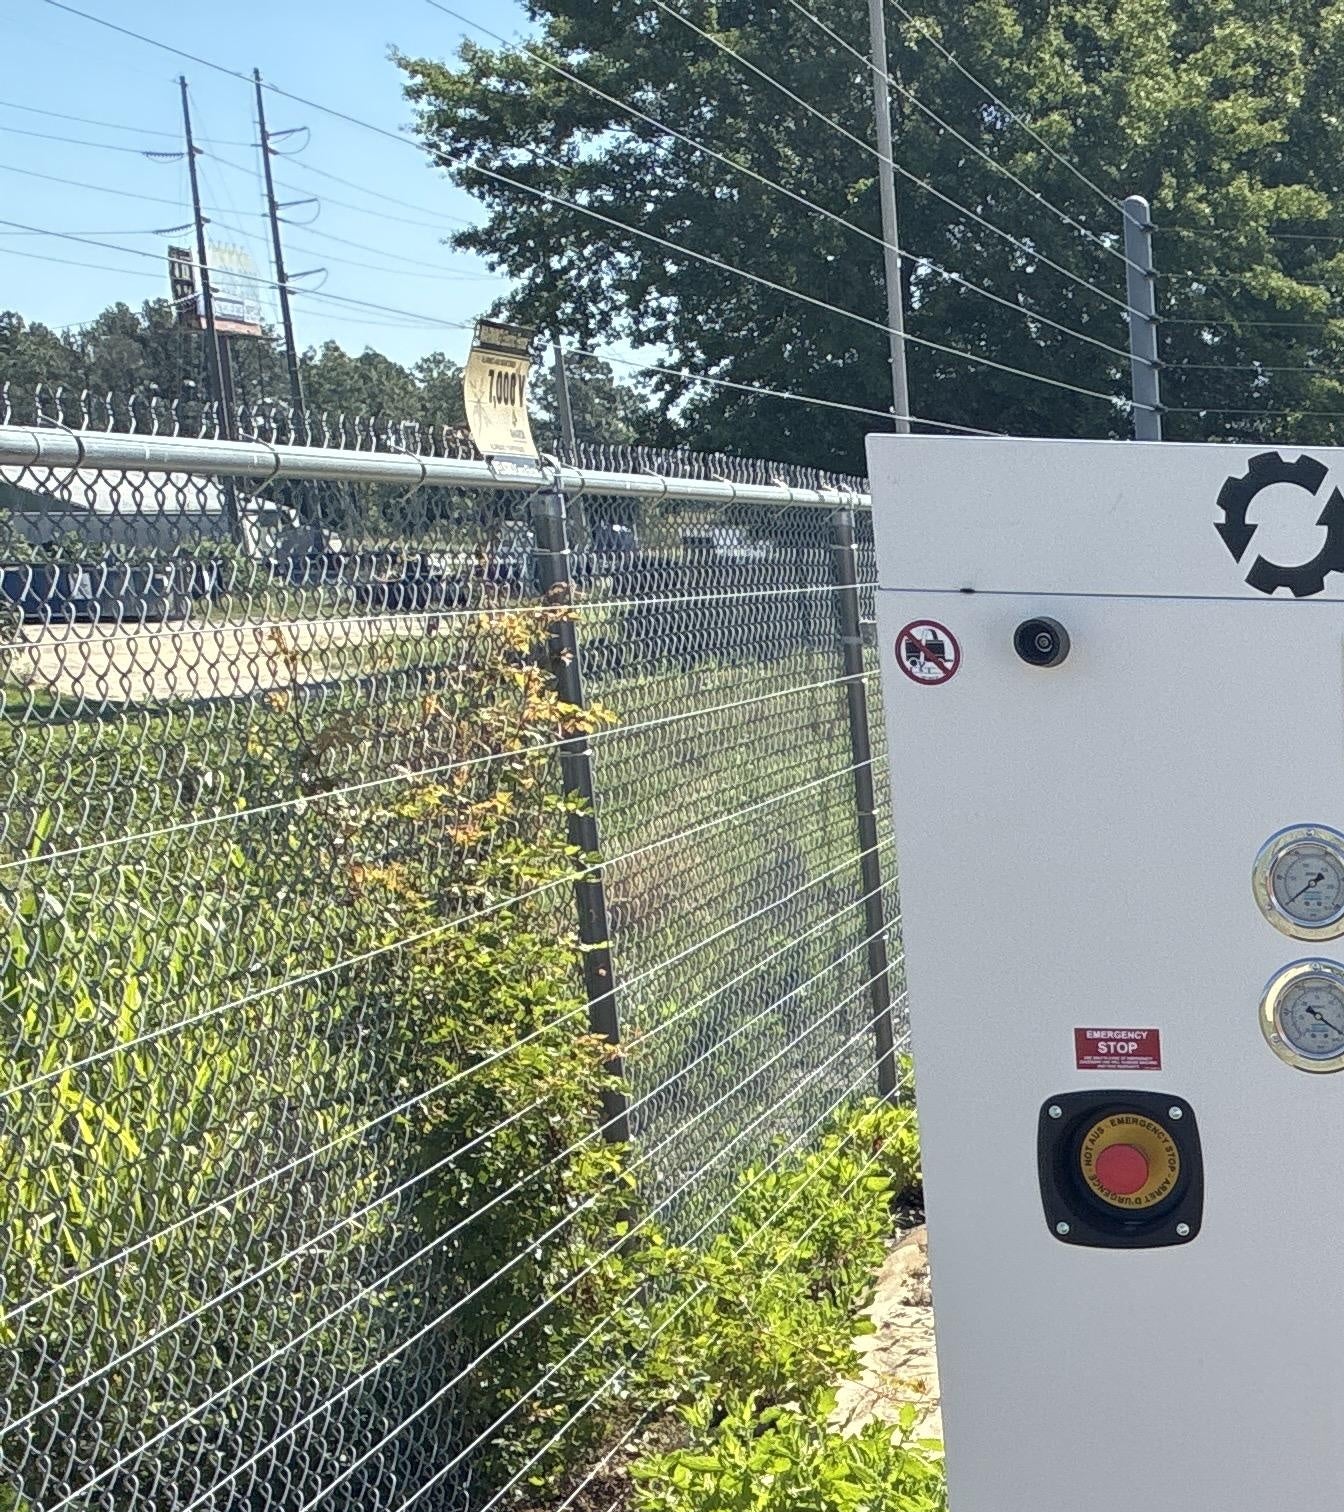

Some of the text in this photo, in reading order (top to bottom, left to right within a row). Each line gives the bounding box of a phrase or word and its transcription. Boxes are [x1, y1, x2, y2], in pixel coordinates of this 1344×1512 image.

[1086, 1030, 1148, 1040] EMERGENCY
[1097, 1041, 1138, 1054] STOP
[1109, 1116, 1170, 1144] EMERGENCY
[1165, 1145, 1177, 1173] STOP
